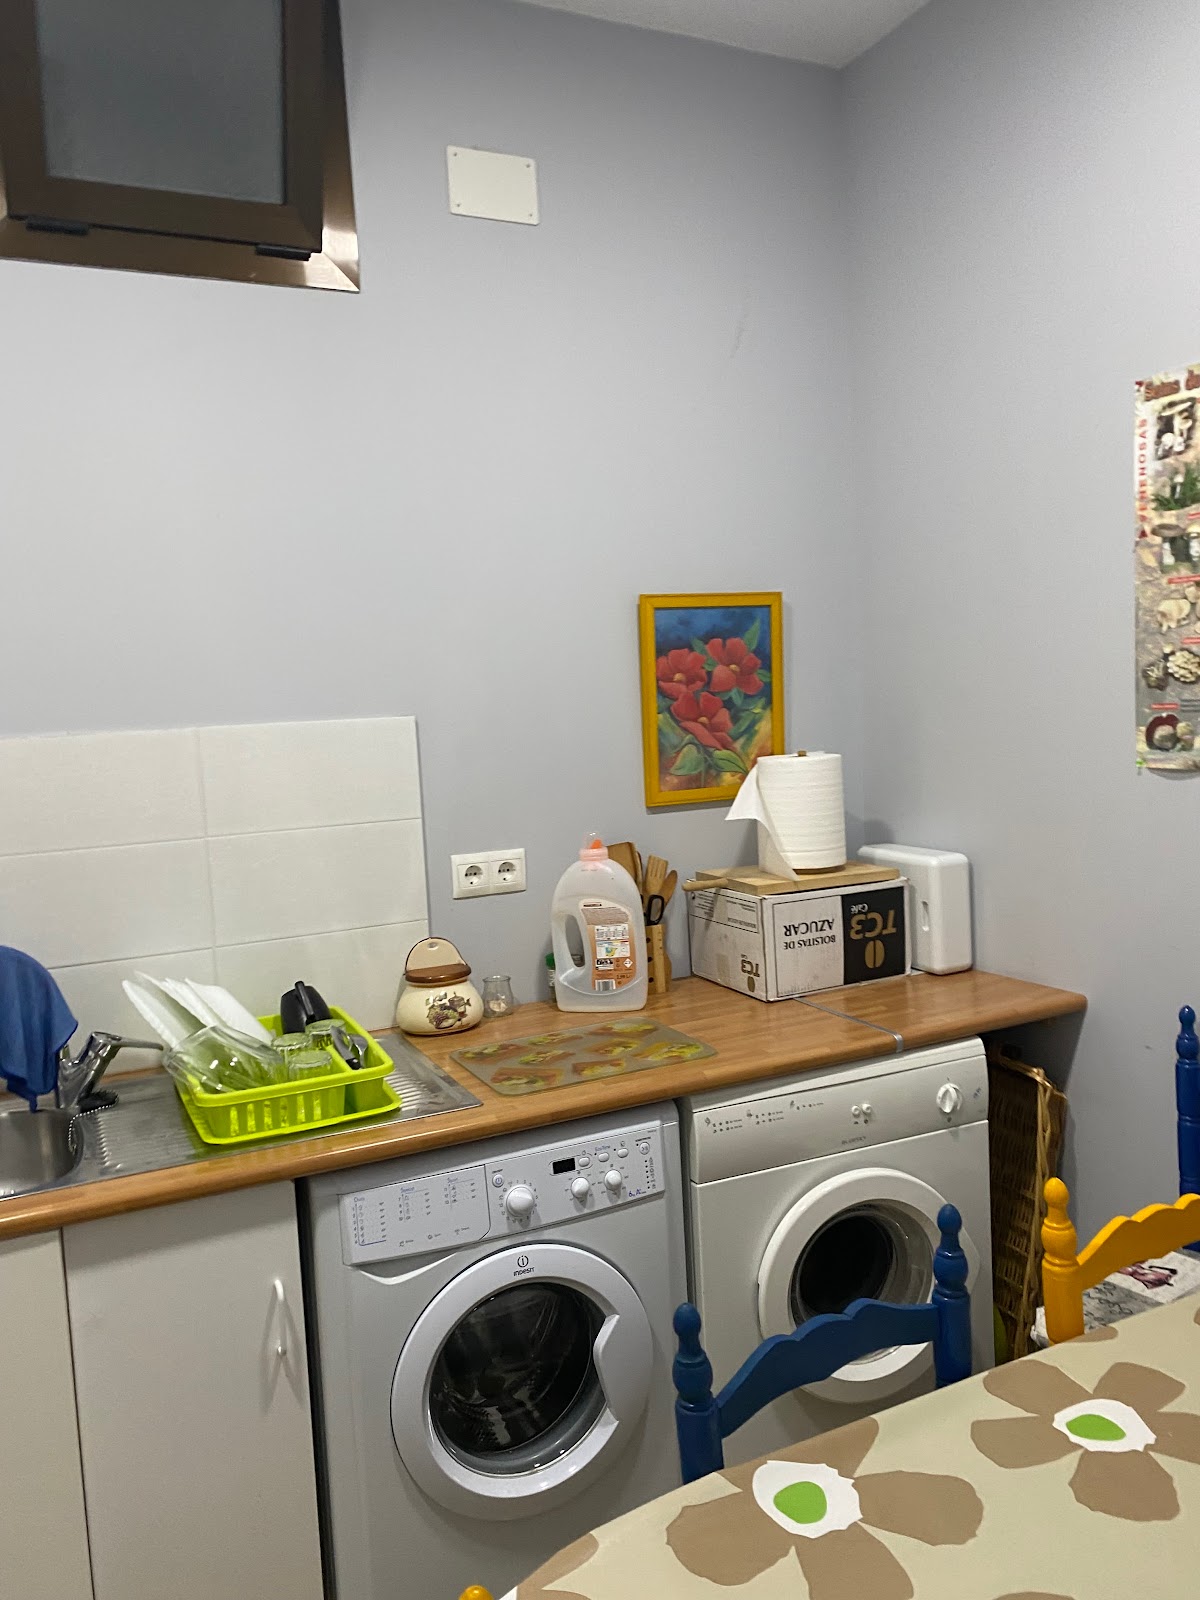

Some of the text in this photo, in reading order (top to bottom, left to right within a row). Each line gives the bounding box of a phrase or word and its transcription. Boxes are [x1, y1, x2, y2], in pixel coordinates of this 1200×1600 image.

[850, 903, 869, 914] Café
[783, 918, 835, 937] AZUCAR
[849, 909, 897, 940] TC3
[783, 935, 837, 951] BOLSITAS DE
[741, 959, 761, 978] TC3
